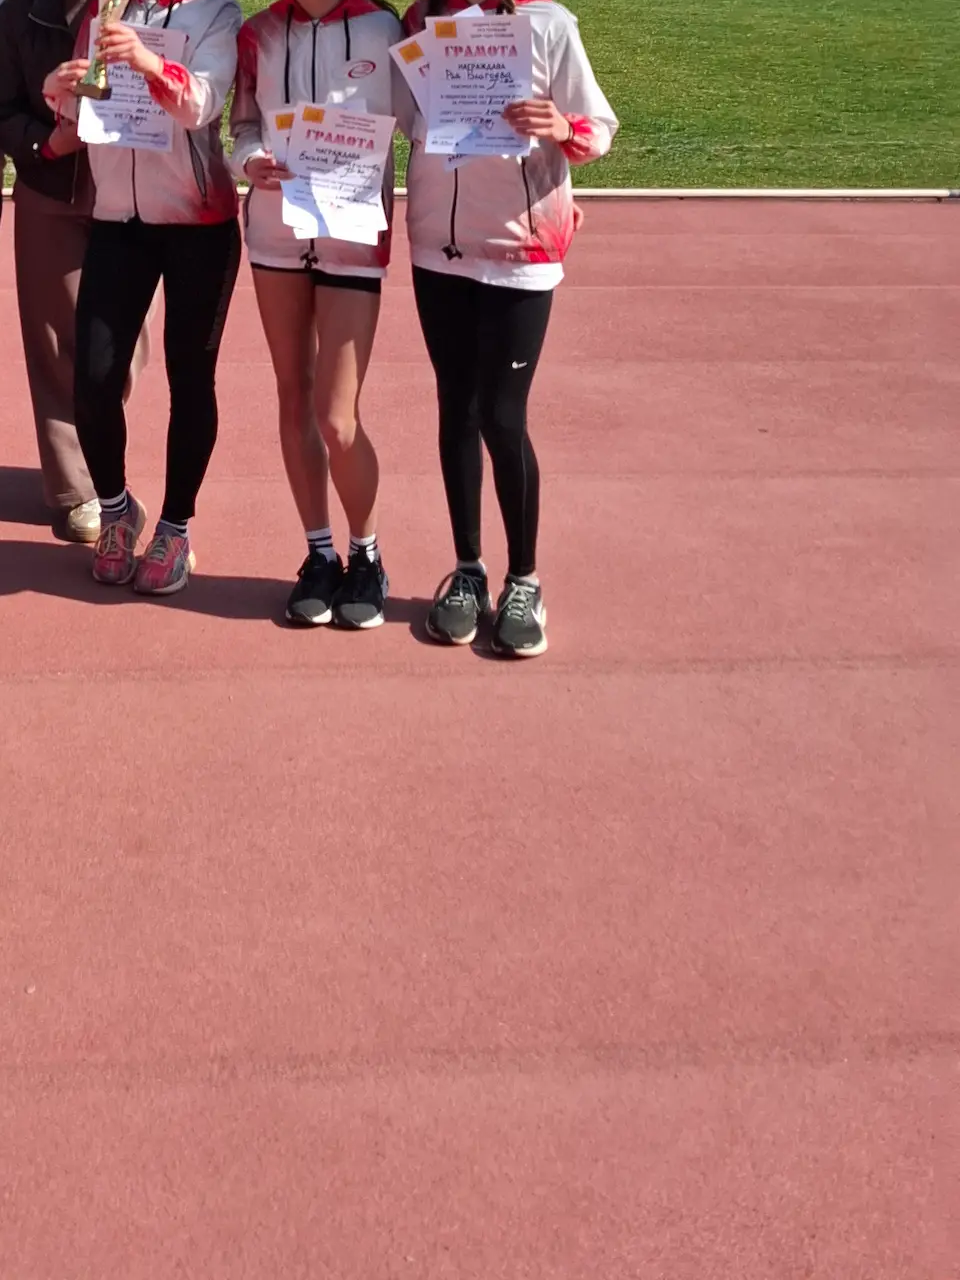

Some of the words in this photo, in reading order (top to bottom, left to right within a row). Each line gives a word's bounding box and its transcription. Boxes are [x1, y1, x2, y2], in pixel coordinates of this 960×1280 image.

[444, 45, 518, 58] ГРАМОТА
[458, 63, 506, 71] НАГРАЖДАВА
[306, 129, 374, 149] ГРАМОТА
[316, 148, 360, 159] НАГРАЖДАВА
